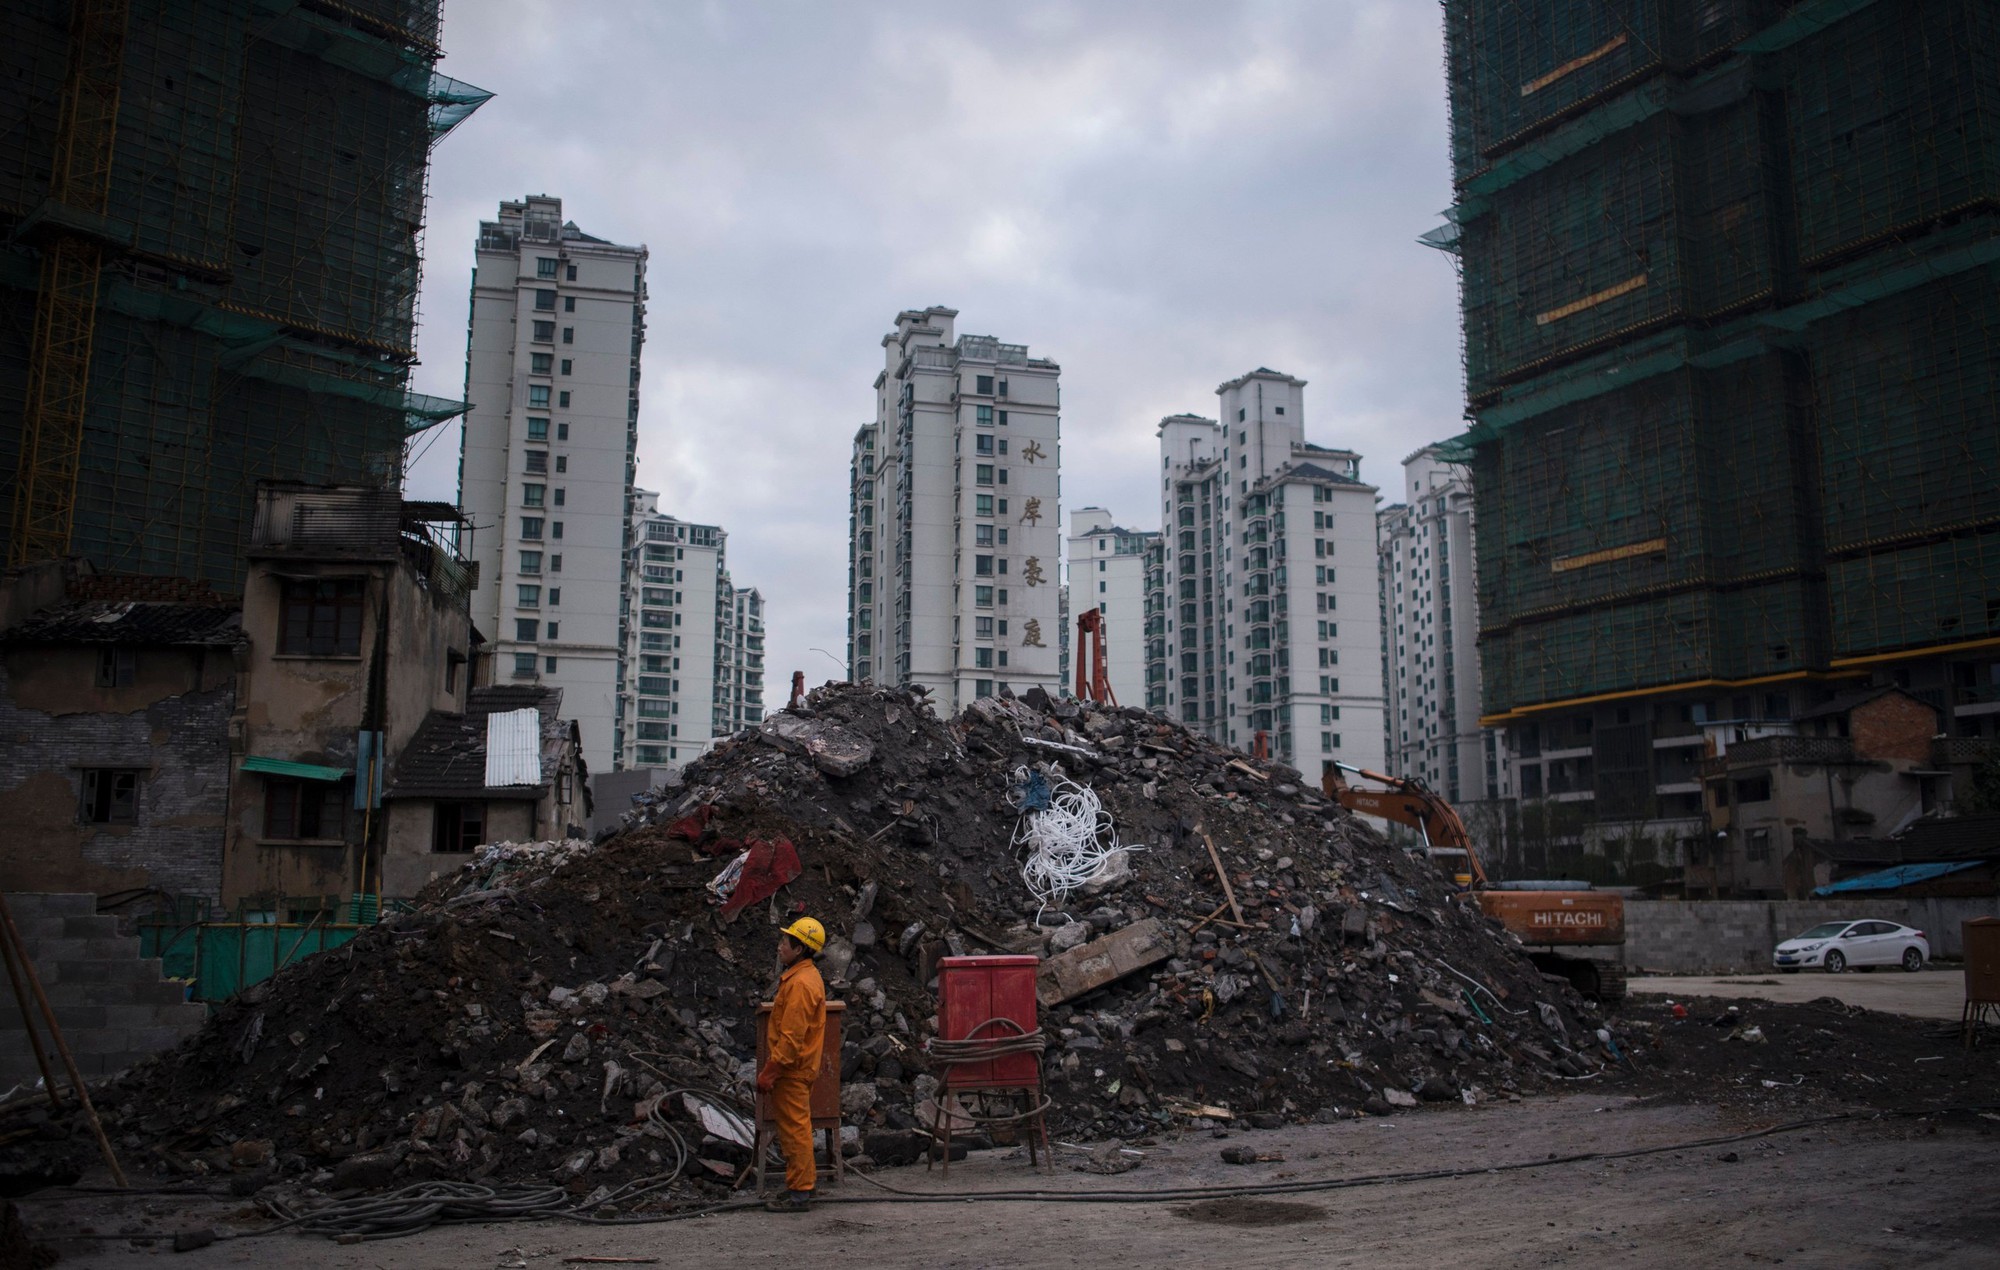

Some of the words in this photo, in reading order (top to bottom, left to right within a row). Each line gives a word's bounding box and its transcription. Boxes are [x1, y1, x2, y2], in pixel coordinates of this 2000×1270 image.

[1019, 439, 1047, 649] 水岸豪庭
[1534, 912, 1602, 925] HITACHI
